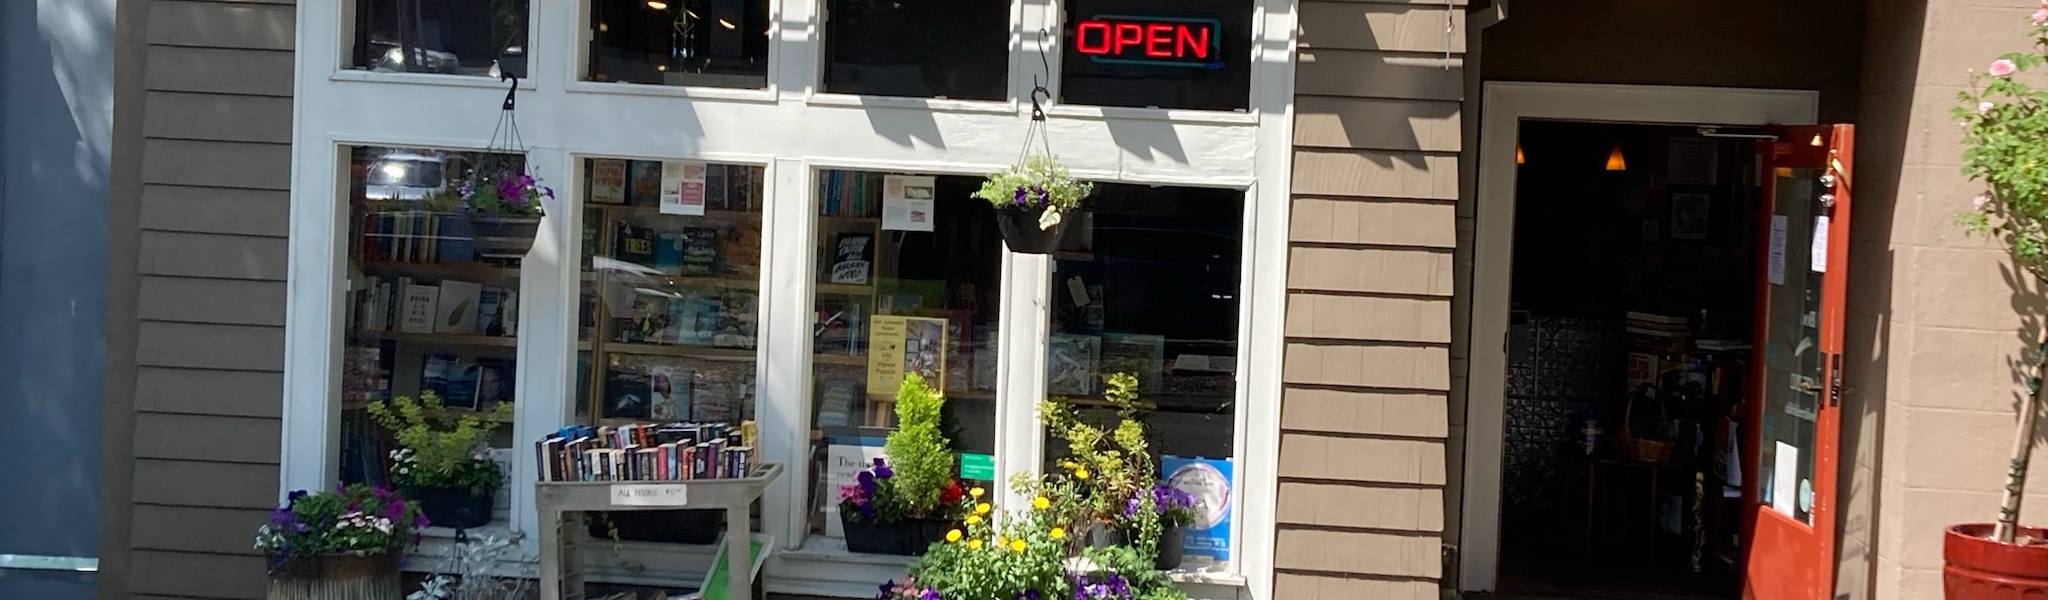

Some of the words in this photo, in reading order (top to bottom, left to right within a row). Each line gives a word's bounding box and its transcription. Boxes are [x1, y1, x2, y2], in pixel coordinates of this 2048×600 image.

[1077, 21, 1208, 58] OPEN
[625, 238, 652, 255] TREES
[837, 455, 855, 467] The
[618, 488, 630, 498] ALL
